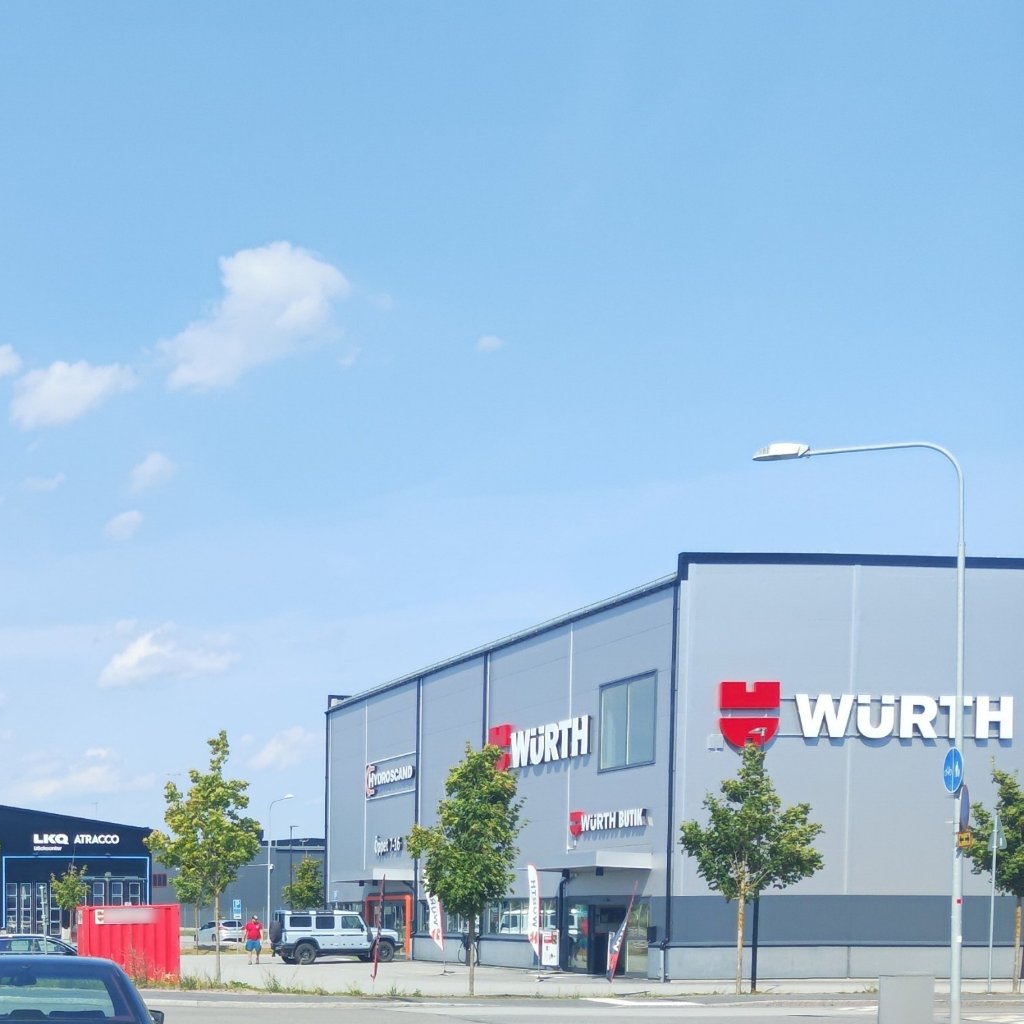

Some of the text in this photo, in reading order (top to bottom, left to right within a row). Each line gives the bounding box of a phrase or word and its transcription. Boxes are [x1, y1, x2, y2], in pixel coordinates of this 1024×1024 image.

[795, 694, 1013, 740] WÜRTH
[510, 714, 589, 769] WÜRTH
[368, 765, 413, 788] HYDROSCAND
[580, 808, 643, 832] WÜRTH BUTIK
[33, 833, 120, 845] LKQ ATRACCO
